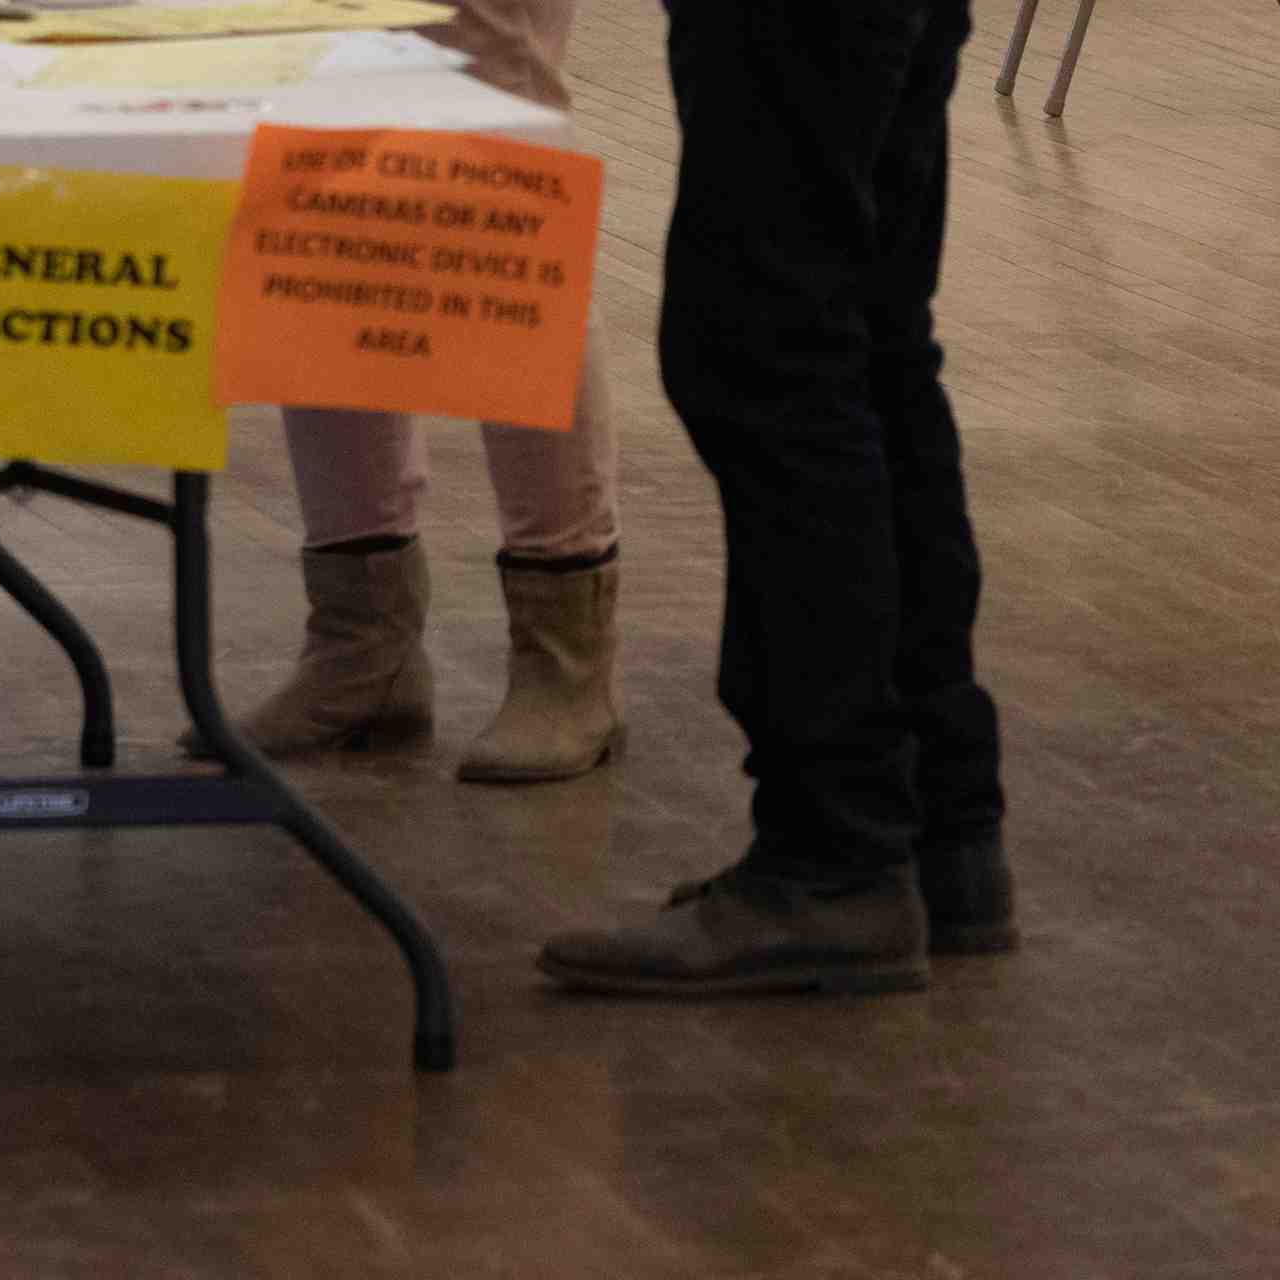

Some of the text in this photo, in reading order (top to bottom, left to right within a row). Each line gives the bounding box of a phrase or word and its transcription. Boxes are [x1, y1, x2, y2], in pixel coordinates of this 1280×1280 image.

[379, 151, 439, 179] CELL
[286, 185, 545, 236] CAMERAS OR ANY
[255, 230, 566, 287] ELECTRONIC DEVICE IS
[262, 273, 542, 328] PROHIBITED IN THIS
[355, 326, 431, 356] AREA
